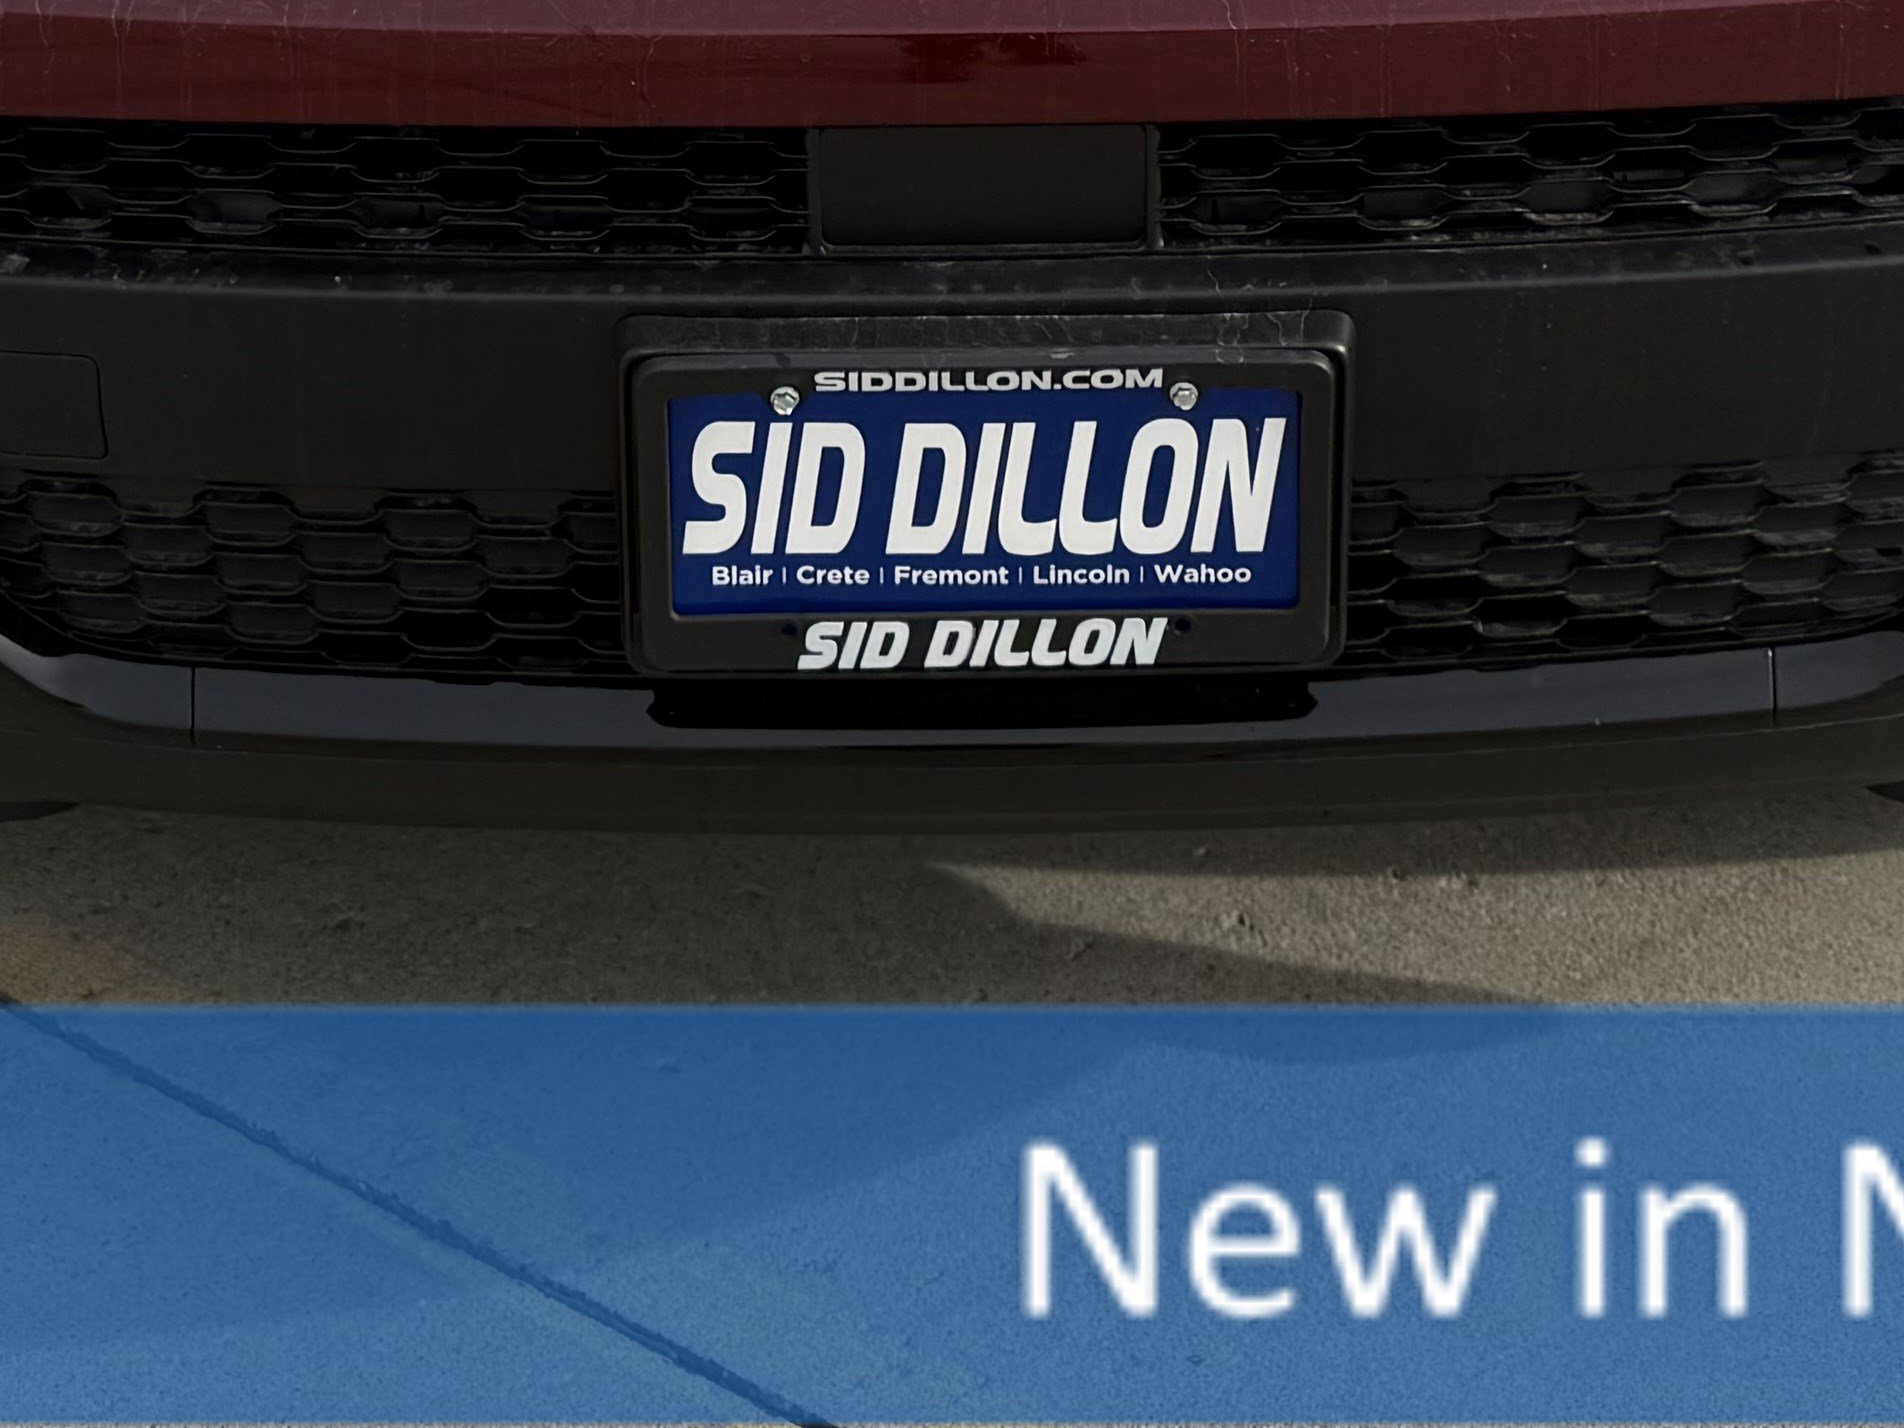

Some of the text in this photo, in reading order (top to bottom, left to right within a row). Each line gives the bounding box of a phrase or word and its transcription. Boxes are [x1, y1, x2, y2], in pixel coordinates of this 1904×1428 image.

[813, 367, 1165, 393] SIDDILLON.COM
[682, 417, 1287, 556] SID DILLON
[711, 563, 1253, 587] Blair Crete Fremont Lincoln Wahoo
[797, 617, 1170, 671] SID DILLON
